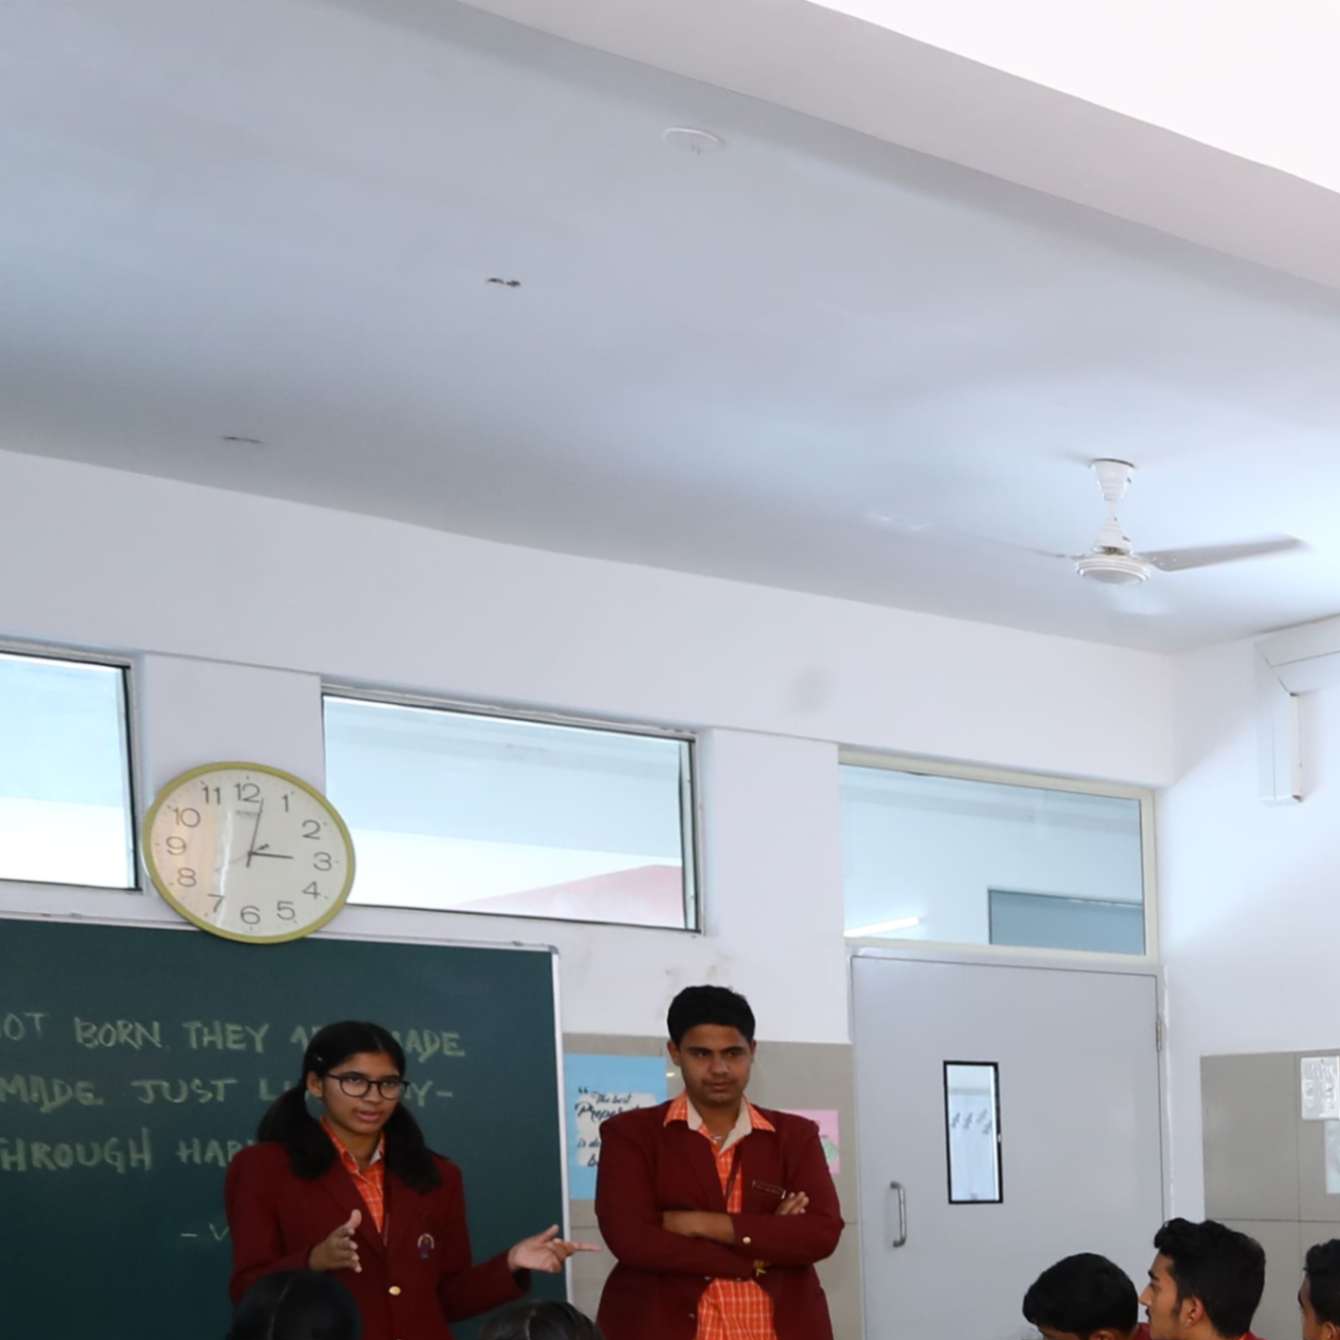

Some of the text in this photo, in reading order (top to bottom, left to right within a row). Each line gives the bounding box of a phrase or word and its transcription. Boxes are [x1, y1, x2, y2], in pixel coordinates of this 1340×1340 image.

[202, 786, 221, 805] 11
[234, 783, 261, 804] 12
[282, 794, 290, 813] 1
[173, 807, 201, 828] 10
[302, 820, 322, 840] 2
[165, 836, 187, 856] 9
[313, 852, 332, 872] 3
[177, 867, 198, 888] 8
[302, 881, 321, 899] 4
[207, 893, 225, 913] 7
[276, 900, 296, 921] 5
[240, 906, 261, 925] 6
[0, 1013, 47, 1041] OT
[182, 1020, 270, 1054] THEY
[130, 1077, 239, 1104] JUST
